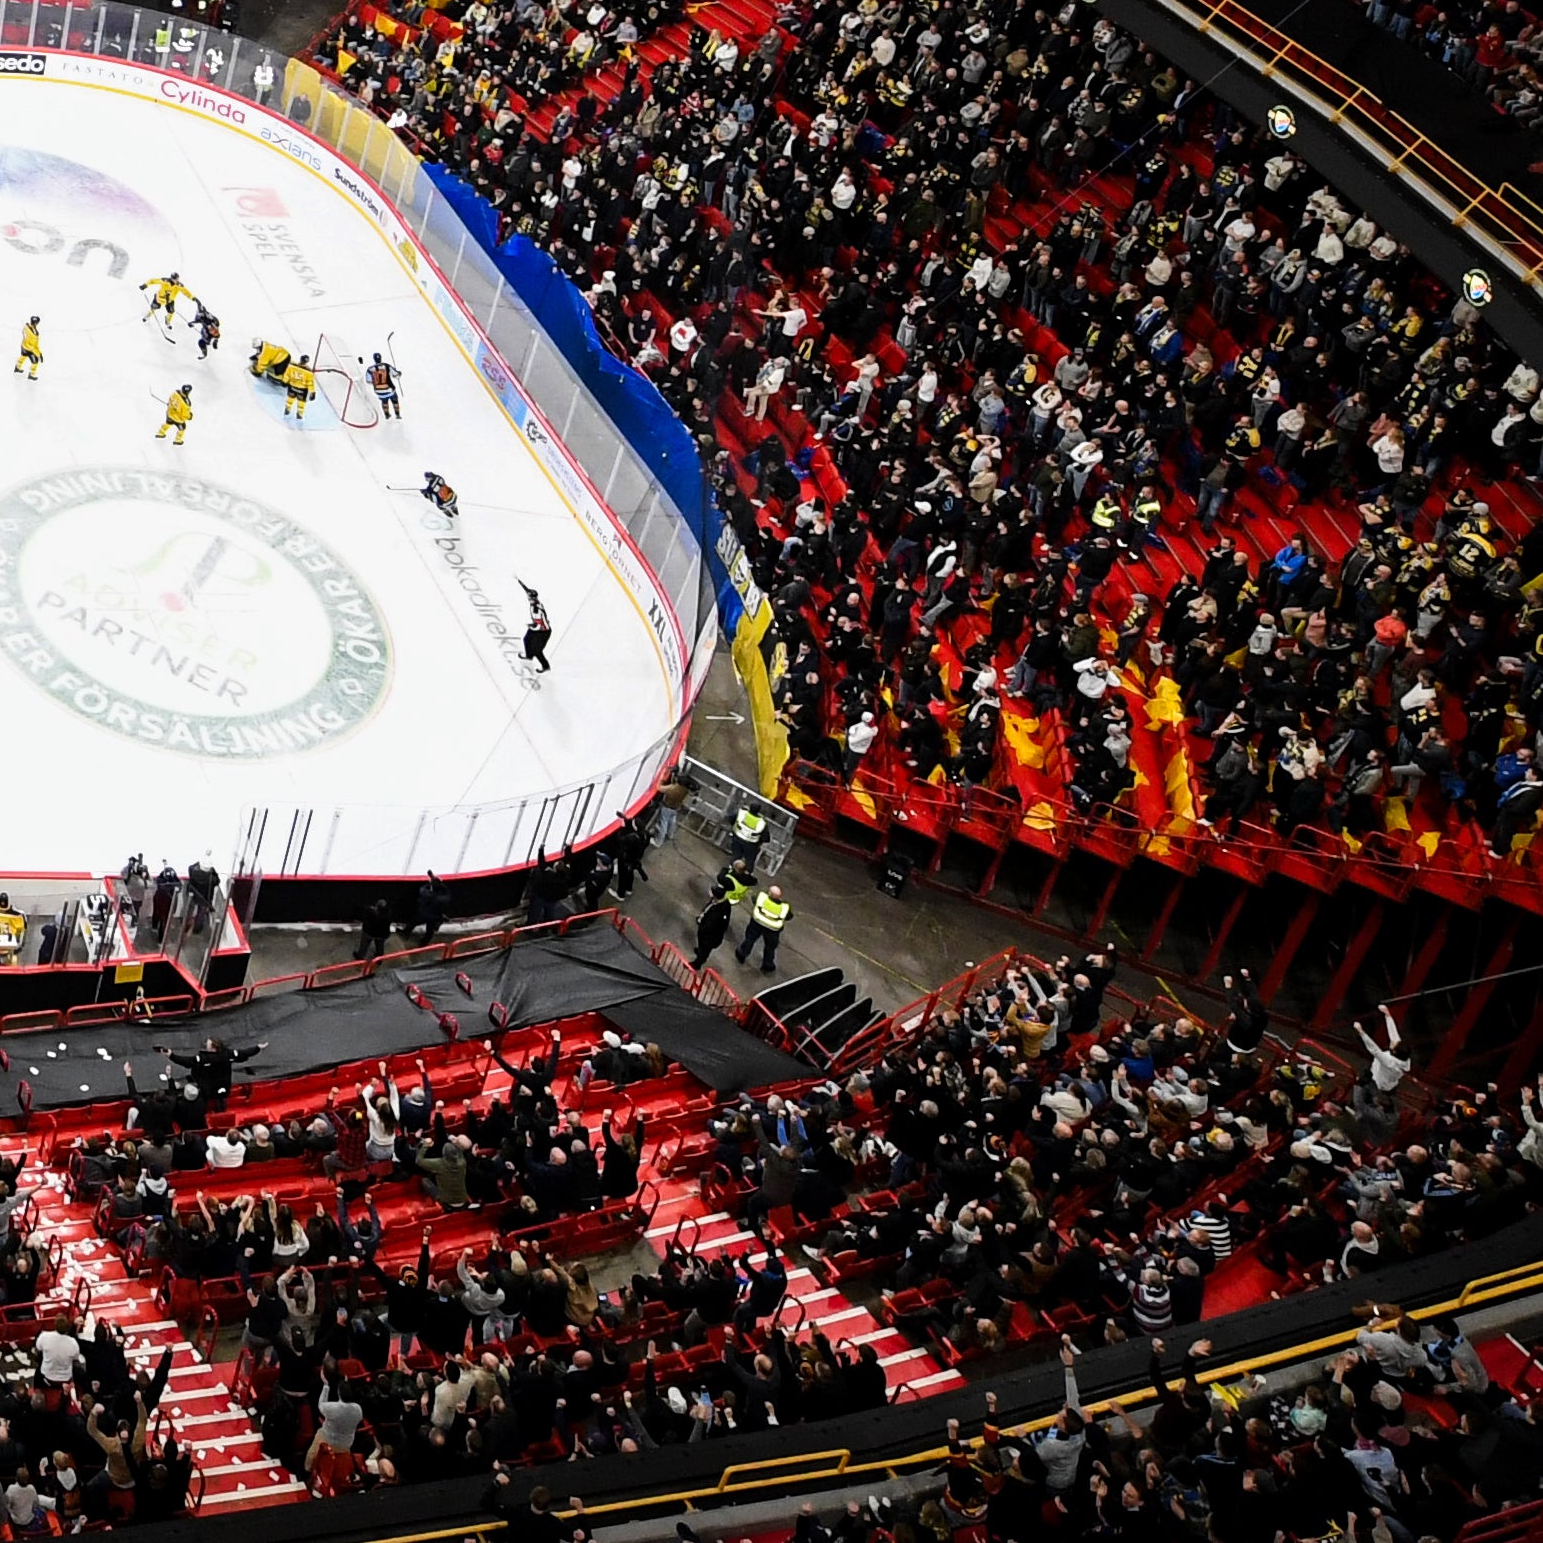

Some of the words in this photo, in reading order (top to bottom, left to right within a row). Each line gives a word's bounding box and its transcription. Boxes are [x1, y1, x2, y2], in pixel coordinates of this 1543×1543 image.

[161, 80, 246, 124] Cylinda
[260, 127, 322, 171] axians
[334, 168, 380, 216] Sundström
[242, 223, 278, 262] SPEL
[268, 224, 326, 298] SVENSKA
[286, 538, 334, 573] ER
[435, 537, 542, 691] bokadirekt.se
[648, 598, 667, 636] XXL
[36, 591, 249, 708] PARTNER
[4, 631, 53, 674] ER
[51, 671, 343, 756] FÖRSÄLJNING
